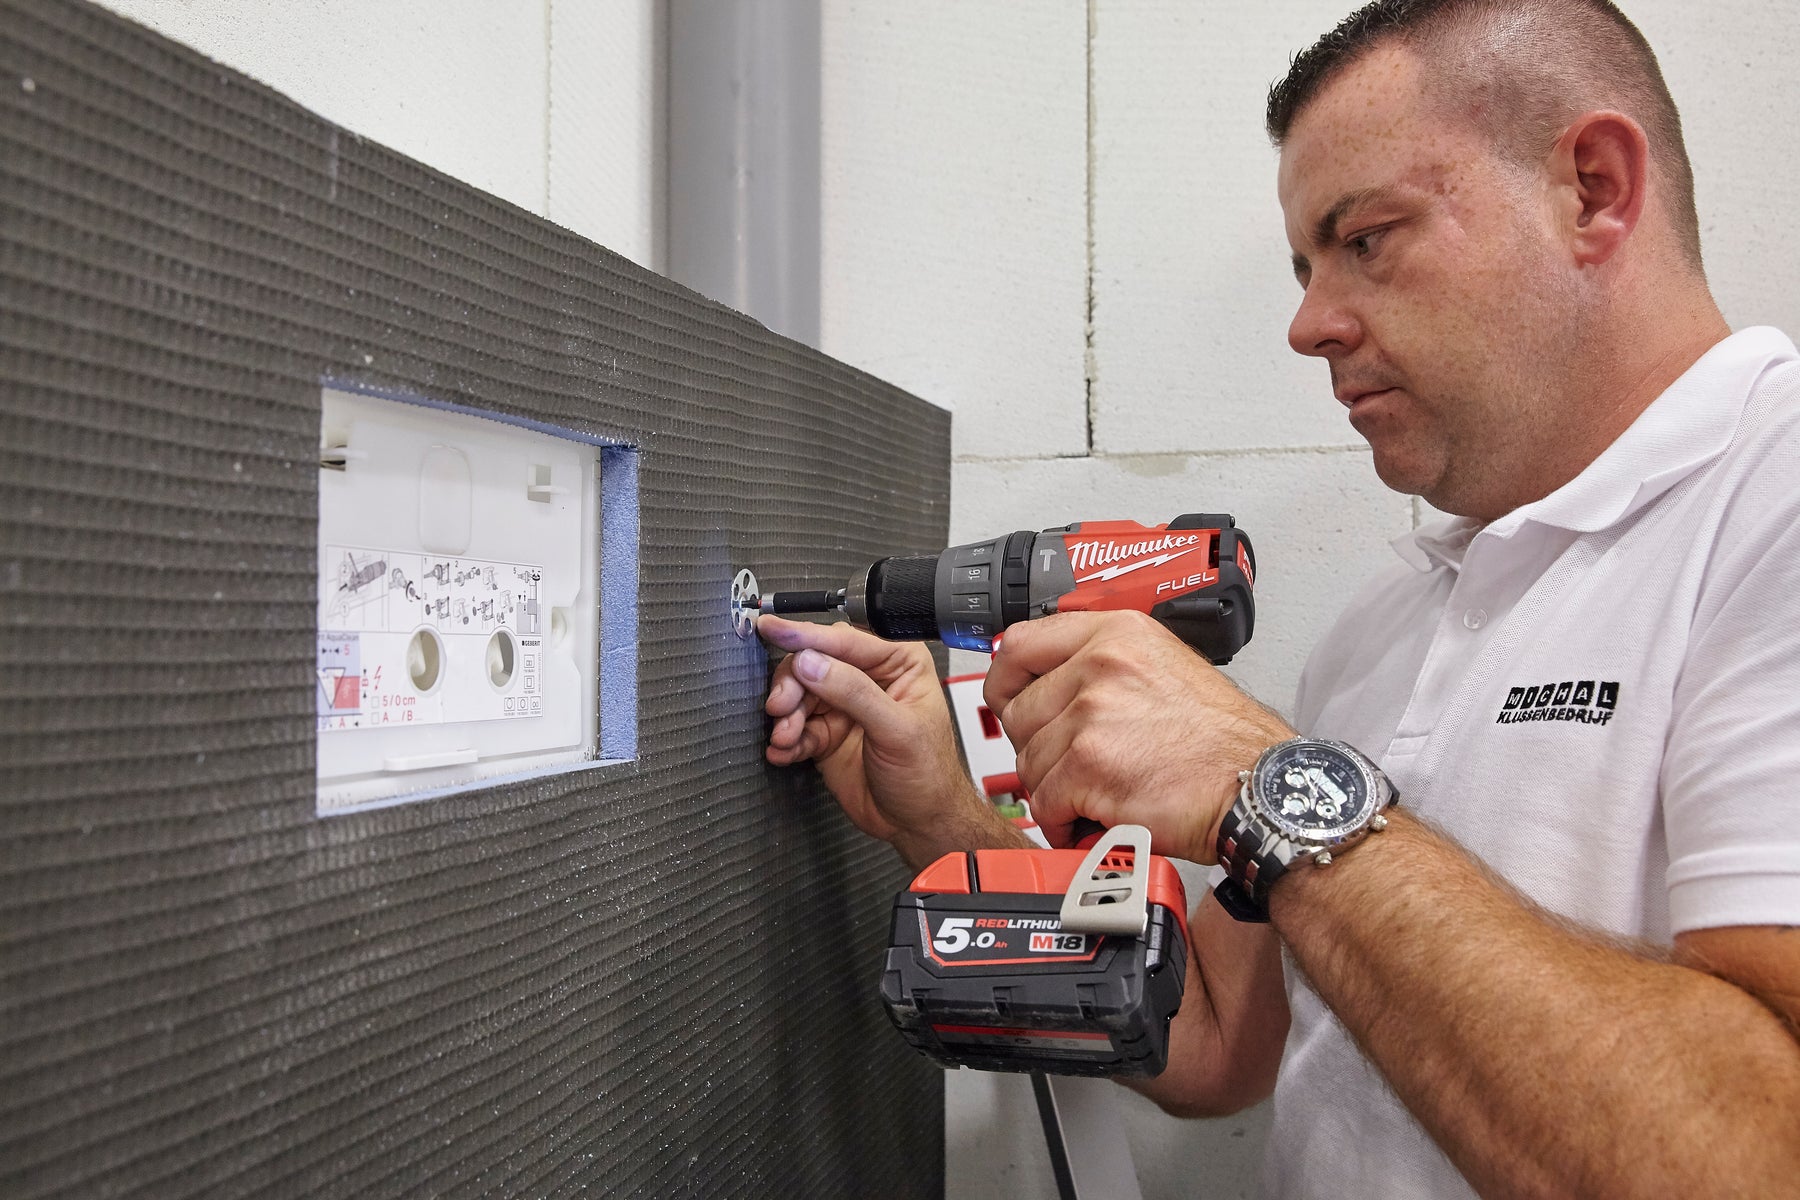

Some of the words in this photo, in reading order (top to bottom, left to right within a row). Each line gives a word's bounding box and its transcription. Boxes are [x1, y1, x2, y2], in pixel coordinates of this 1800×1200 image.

[1068, 534, 1200, 572] Milwaukee
[968, 568, 981, 580] 16
[1156, 572, 1215, 595] FUEL
[968, 597, 981, 609] 14
[972, 625, 985, 635] 12
[344, 643, 350, 656] 5
[402, 696, 416, 706] cm
[1503, 680, 1620, 710] MICHAL
[339, 717, 345, 727] A
[1496, 707, 1614, 726] KLUSSENBEDRIJF
[975, 918, 1062, 930] REDLITHIU
[994, 940, 1008, 949] Ah
[1032, 935, 1082, 950] M18
